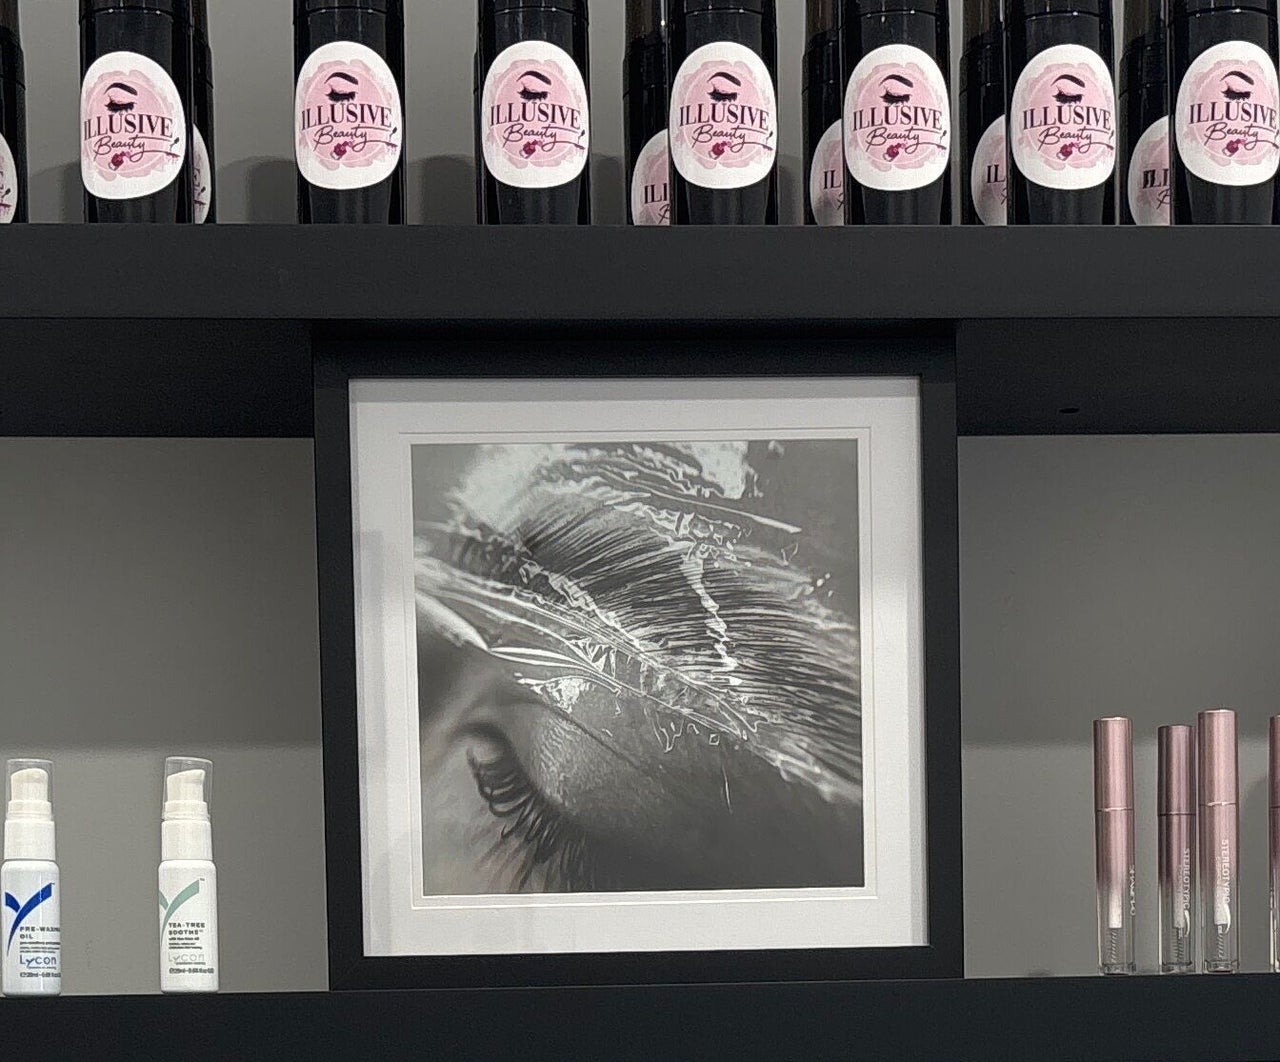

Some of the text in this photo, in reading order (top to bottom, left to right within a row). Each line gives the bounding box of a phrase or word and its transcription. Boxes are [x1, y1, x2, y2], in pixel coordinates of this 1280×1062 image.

[84, 113, 174, 141] ILLUSIVE
[302, 103, 392, 131] ILLUSIVE
[491, 102, 581, 130] ILLUSIVE
[680, 103, 770, 131] ILLUSIVE
[853, 106, 943, 132] ILLUSIVE
[1023, 105, 1112, 132] ILLUSIVE
[1190, 101, 1278, 130] ILLUSIVE
[20, 955, 56, 968] Lycon
